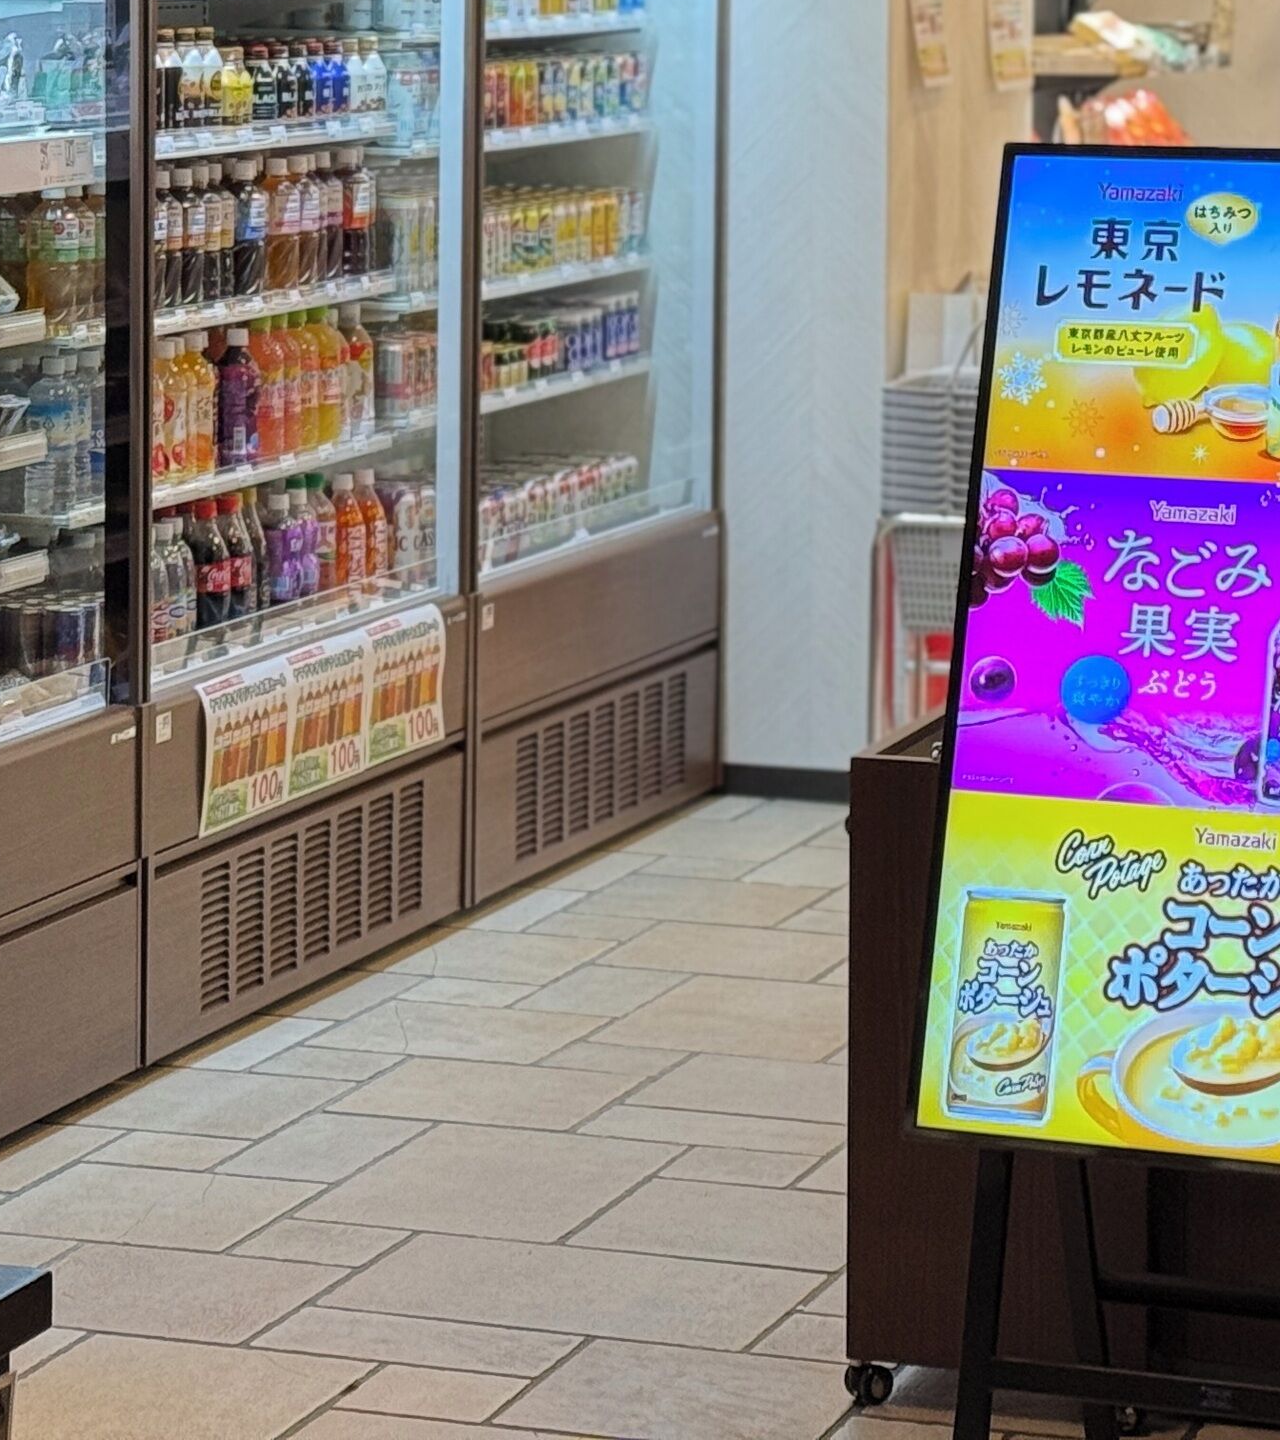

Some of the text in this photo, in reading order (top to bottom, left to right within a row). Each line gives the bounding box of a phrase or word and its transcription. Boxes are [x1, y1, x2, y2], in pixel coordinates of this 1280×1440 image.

[1098, 182, 1184, 203] Yamazaki
[1194, 205, 1252, 219] はちみつ
[1090, 217, 1182, 262] 東京
[1209, 221, 1233, 235] 入り
[1035, 264, 1226, 313] レモネード
[1067, 327, 1185, 343] 東京都産八丈フルーツ
[1149, 499, 1237, 525] Yamazaki
[1104, 529, 1272, 598] なごみ
[1118, 602, 1241, 663] 果実
[1137, 669, 1216, 701] ぶどう
[1056, 829, 1115, 873] Corn
[1195, 826, 1278, 852] Yamazaki
[1082, 849, 1167, 900] Potage
[983, 938, 1039, 959] あったか
[977, 956, 1043, 987] コーン
[958, 980, 1053, 1019] ポタージュ
